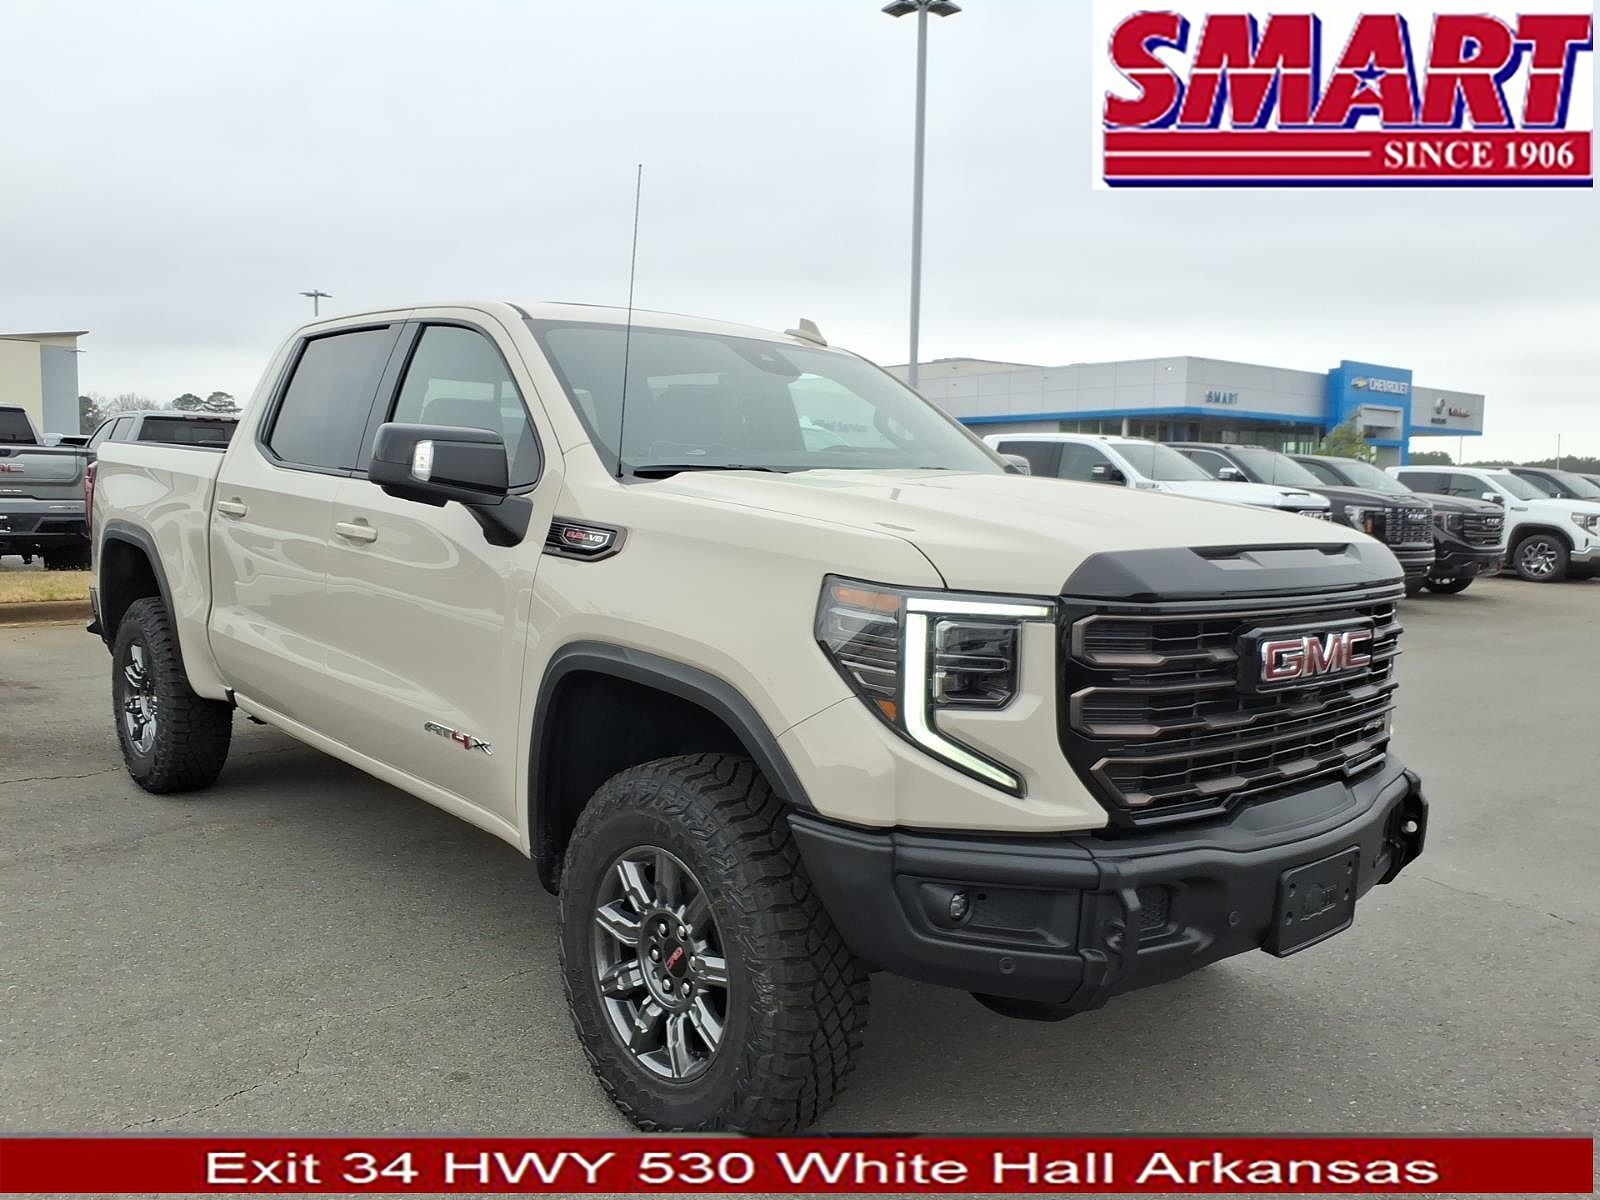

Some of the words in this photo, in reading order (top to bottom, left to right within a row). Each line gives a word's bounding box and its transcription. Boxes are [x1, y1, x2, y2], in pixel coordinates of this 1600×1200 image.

[1204, 389, 1240, 405] SMART
[1261, 629, 1373, 682] GMC
[424, 720, 494, 756] AT4X
